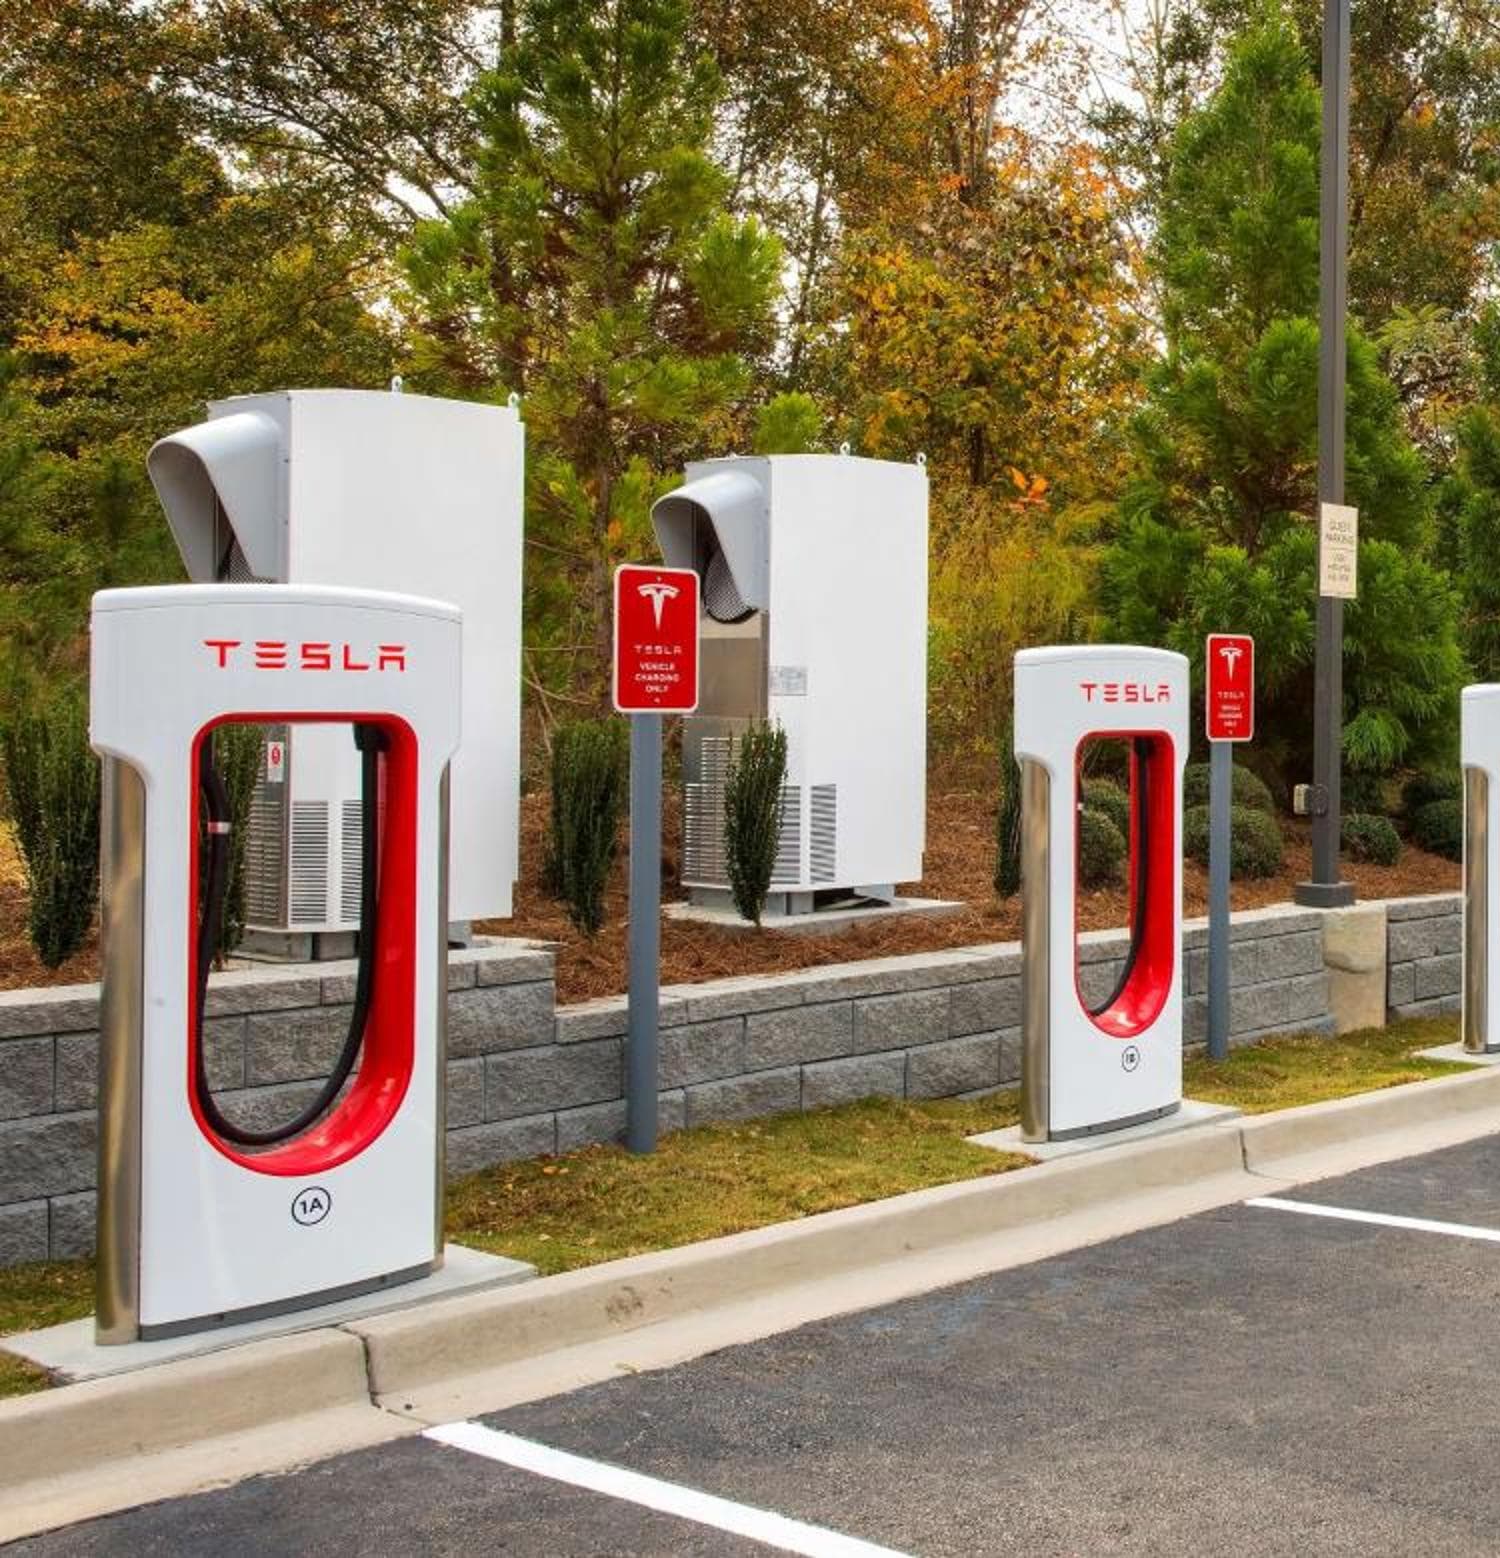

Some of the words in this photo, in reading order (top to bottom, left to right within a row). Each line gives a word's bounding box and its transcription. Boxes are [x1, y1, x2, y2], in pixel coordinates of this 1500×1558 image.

[633, 644, 682, 655] TESLA
[204, 640, 405, 672] TESLA
[640, 662, 675, 671] VEHICLE
[634, 673, 680, 682] CHARGING
[645, 685, 668, 693] ONLY
[1080, 683, 1170, 702] TESLA
[299, 1198, 323, 1214] 1A
